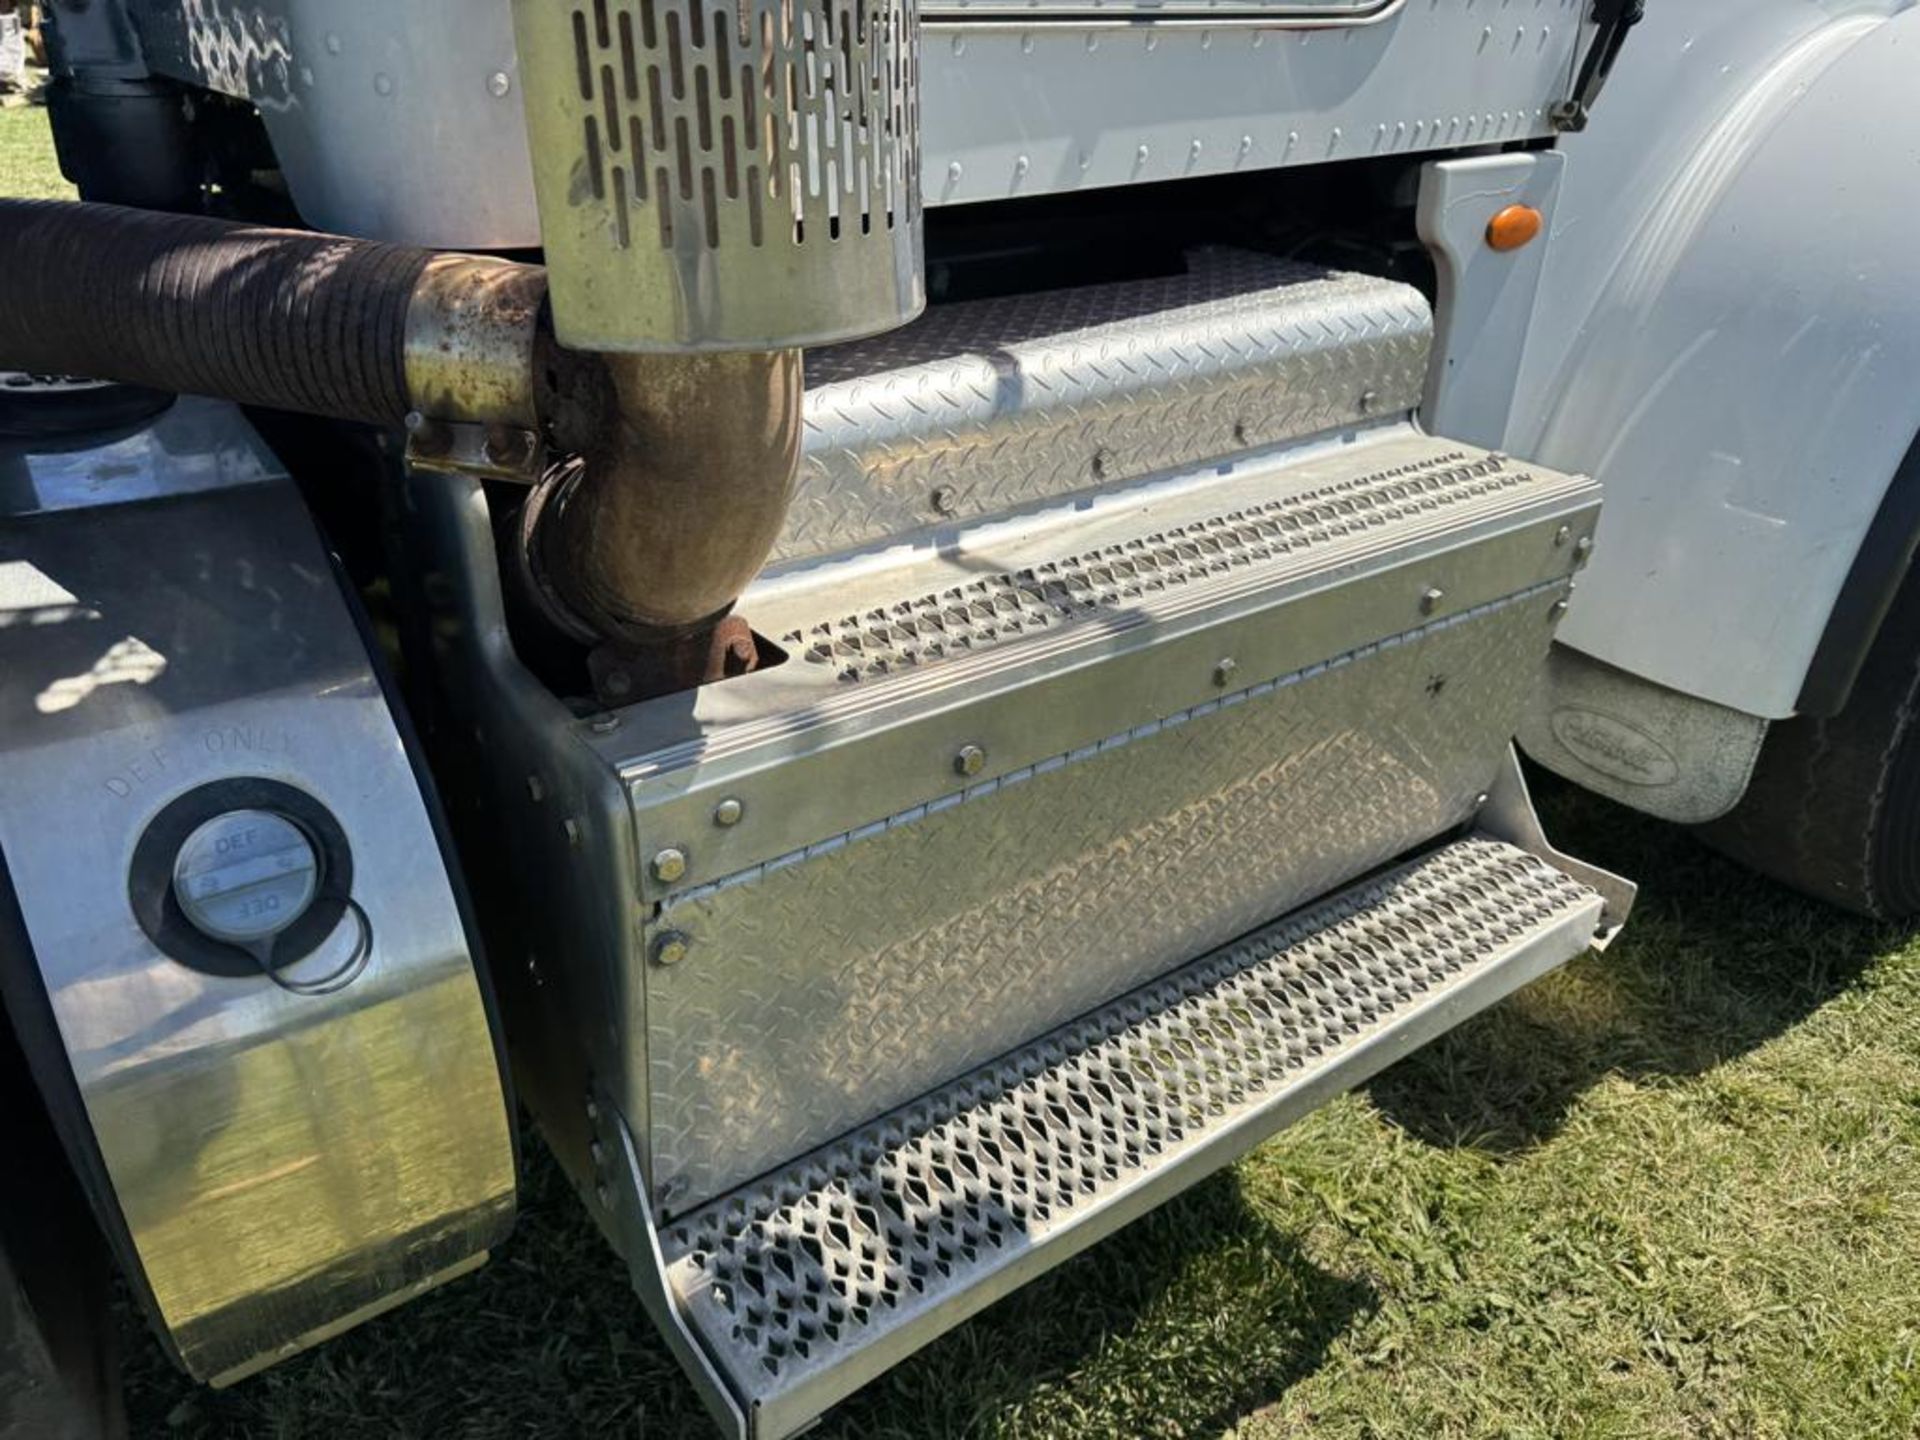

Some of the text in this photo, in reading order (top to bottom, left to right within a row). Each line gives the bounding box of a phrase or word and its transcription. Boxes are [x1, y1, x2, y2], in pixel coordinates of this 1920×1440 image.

[104, 727, 298, 798] DEF ONLY
[215, 829, 259, 854] DEF
[239, 895, 280, 917] DEF
